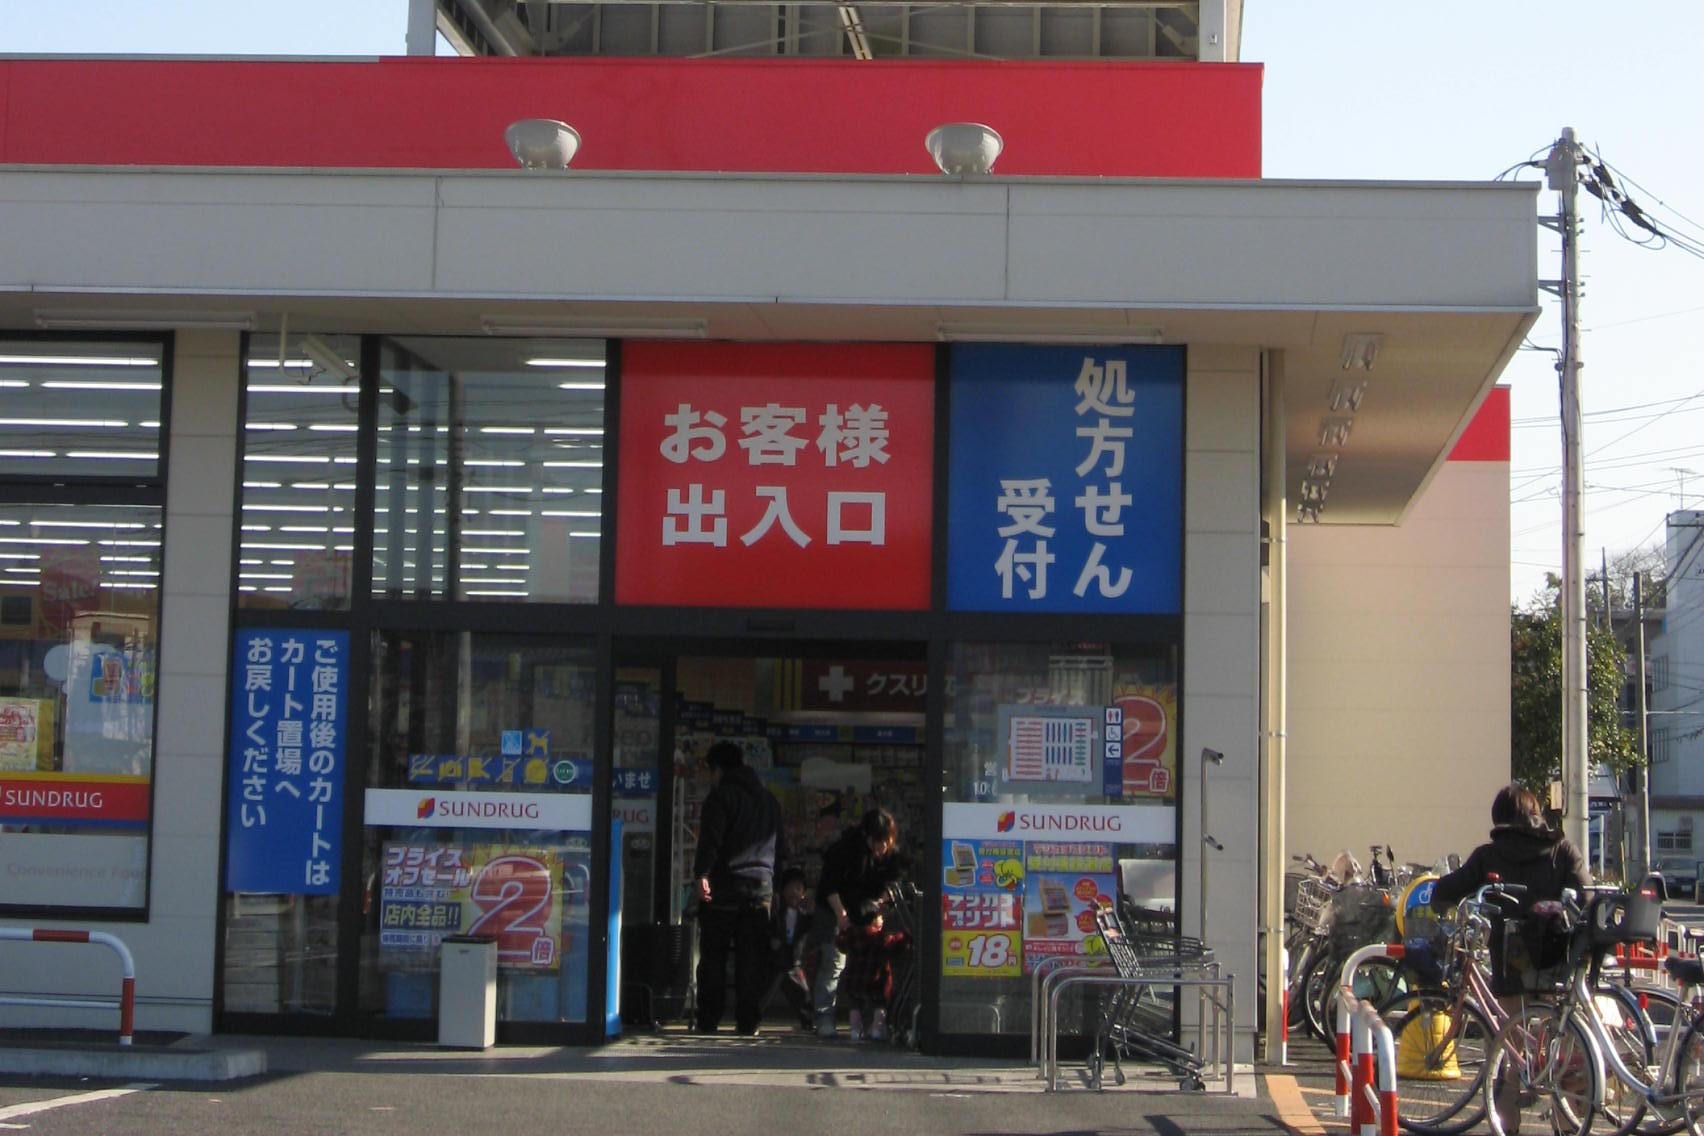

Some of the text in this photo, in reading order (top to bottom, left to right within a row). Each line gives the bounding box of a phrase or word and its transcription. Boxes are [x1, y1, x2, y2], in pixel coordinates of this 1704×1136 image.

[659, 403, 891, 468] お客様
[1073, 357, 1136, 599] 処方せん
[662, 483, 887, 549] 出入口
[994, 478, 1056, 600] 受付
[240, 637, 272, 828] お戻しください
[275, 638, 304, 799] カート置場へ
[305, 639, 339, 886] ご使用後のカートは
[4, 789, 104, 809] SUNDRUG
[439, 800, 540, 819] SUNDRUG
[1019, 814, 1122, 833] SUNDRUG
[385, 867, 471, 888] オフセール
[387, 847, 464, 867] プライス
